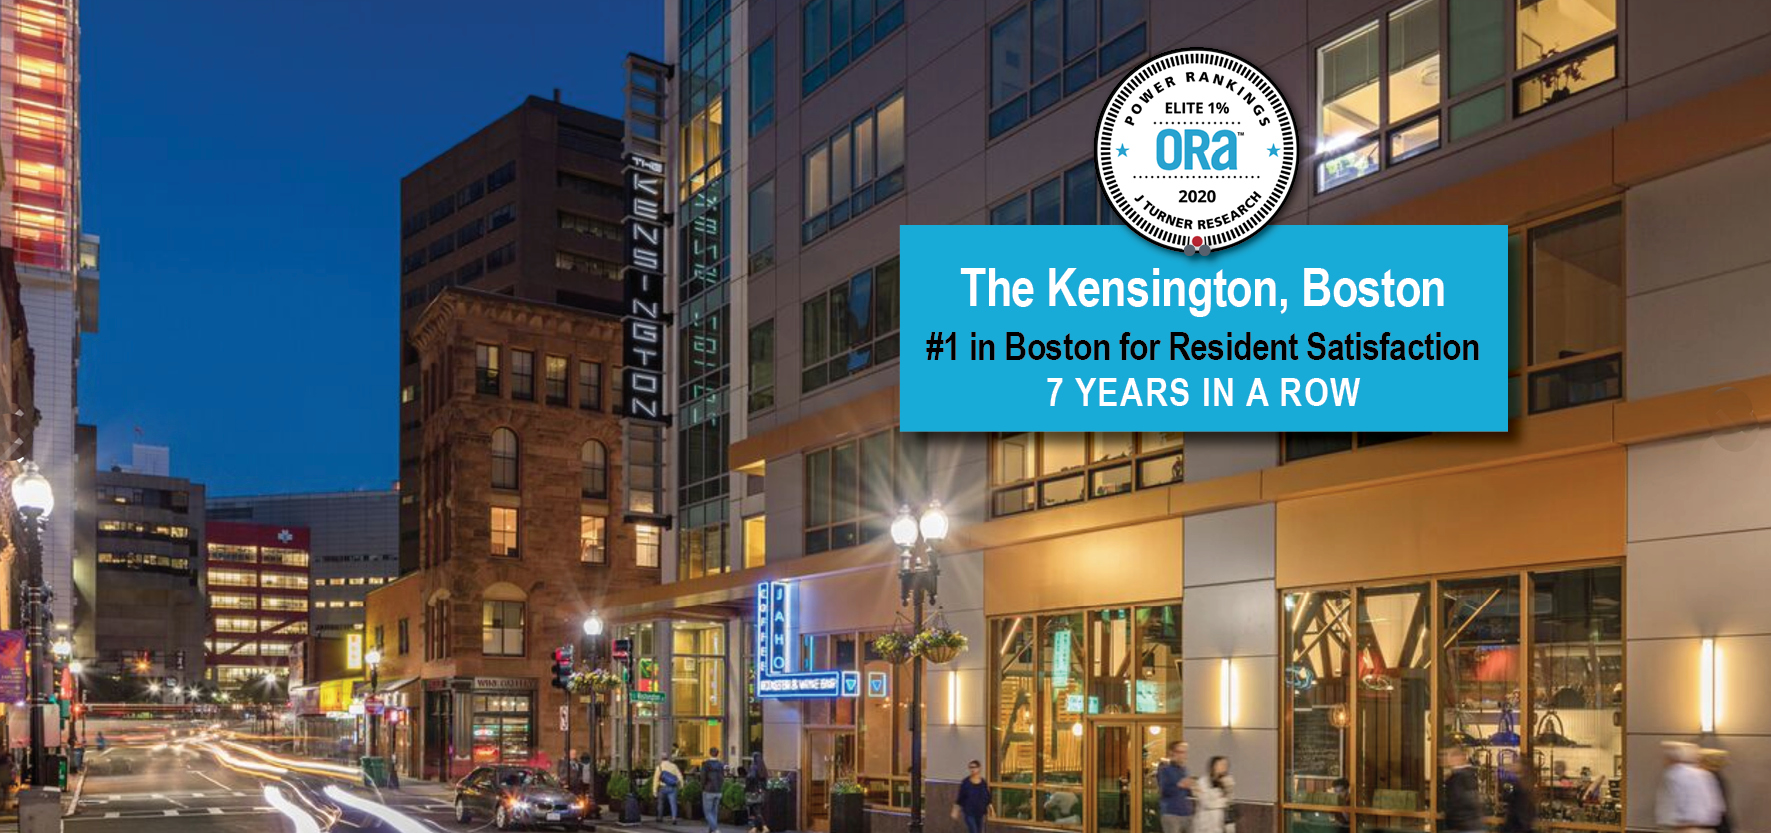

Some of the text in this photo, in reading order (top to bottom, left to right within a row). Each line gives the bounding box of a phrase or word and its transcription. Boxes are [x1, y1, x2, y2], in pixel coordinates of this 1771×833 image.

[632, 156, 662, 173] THE
[632, 173, 659, 417] KENSINGTON
[774, 588, 785, 670] JAHO
